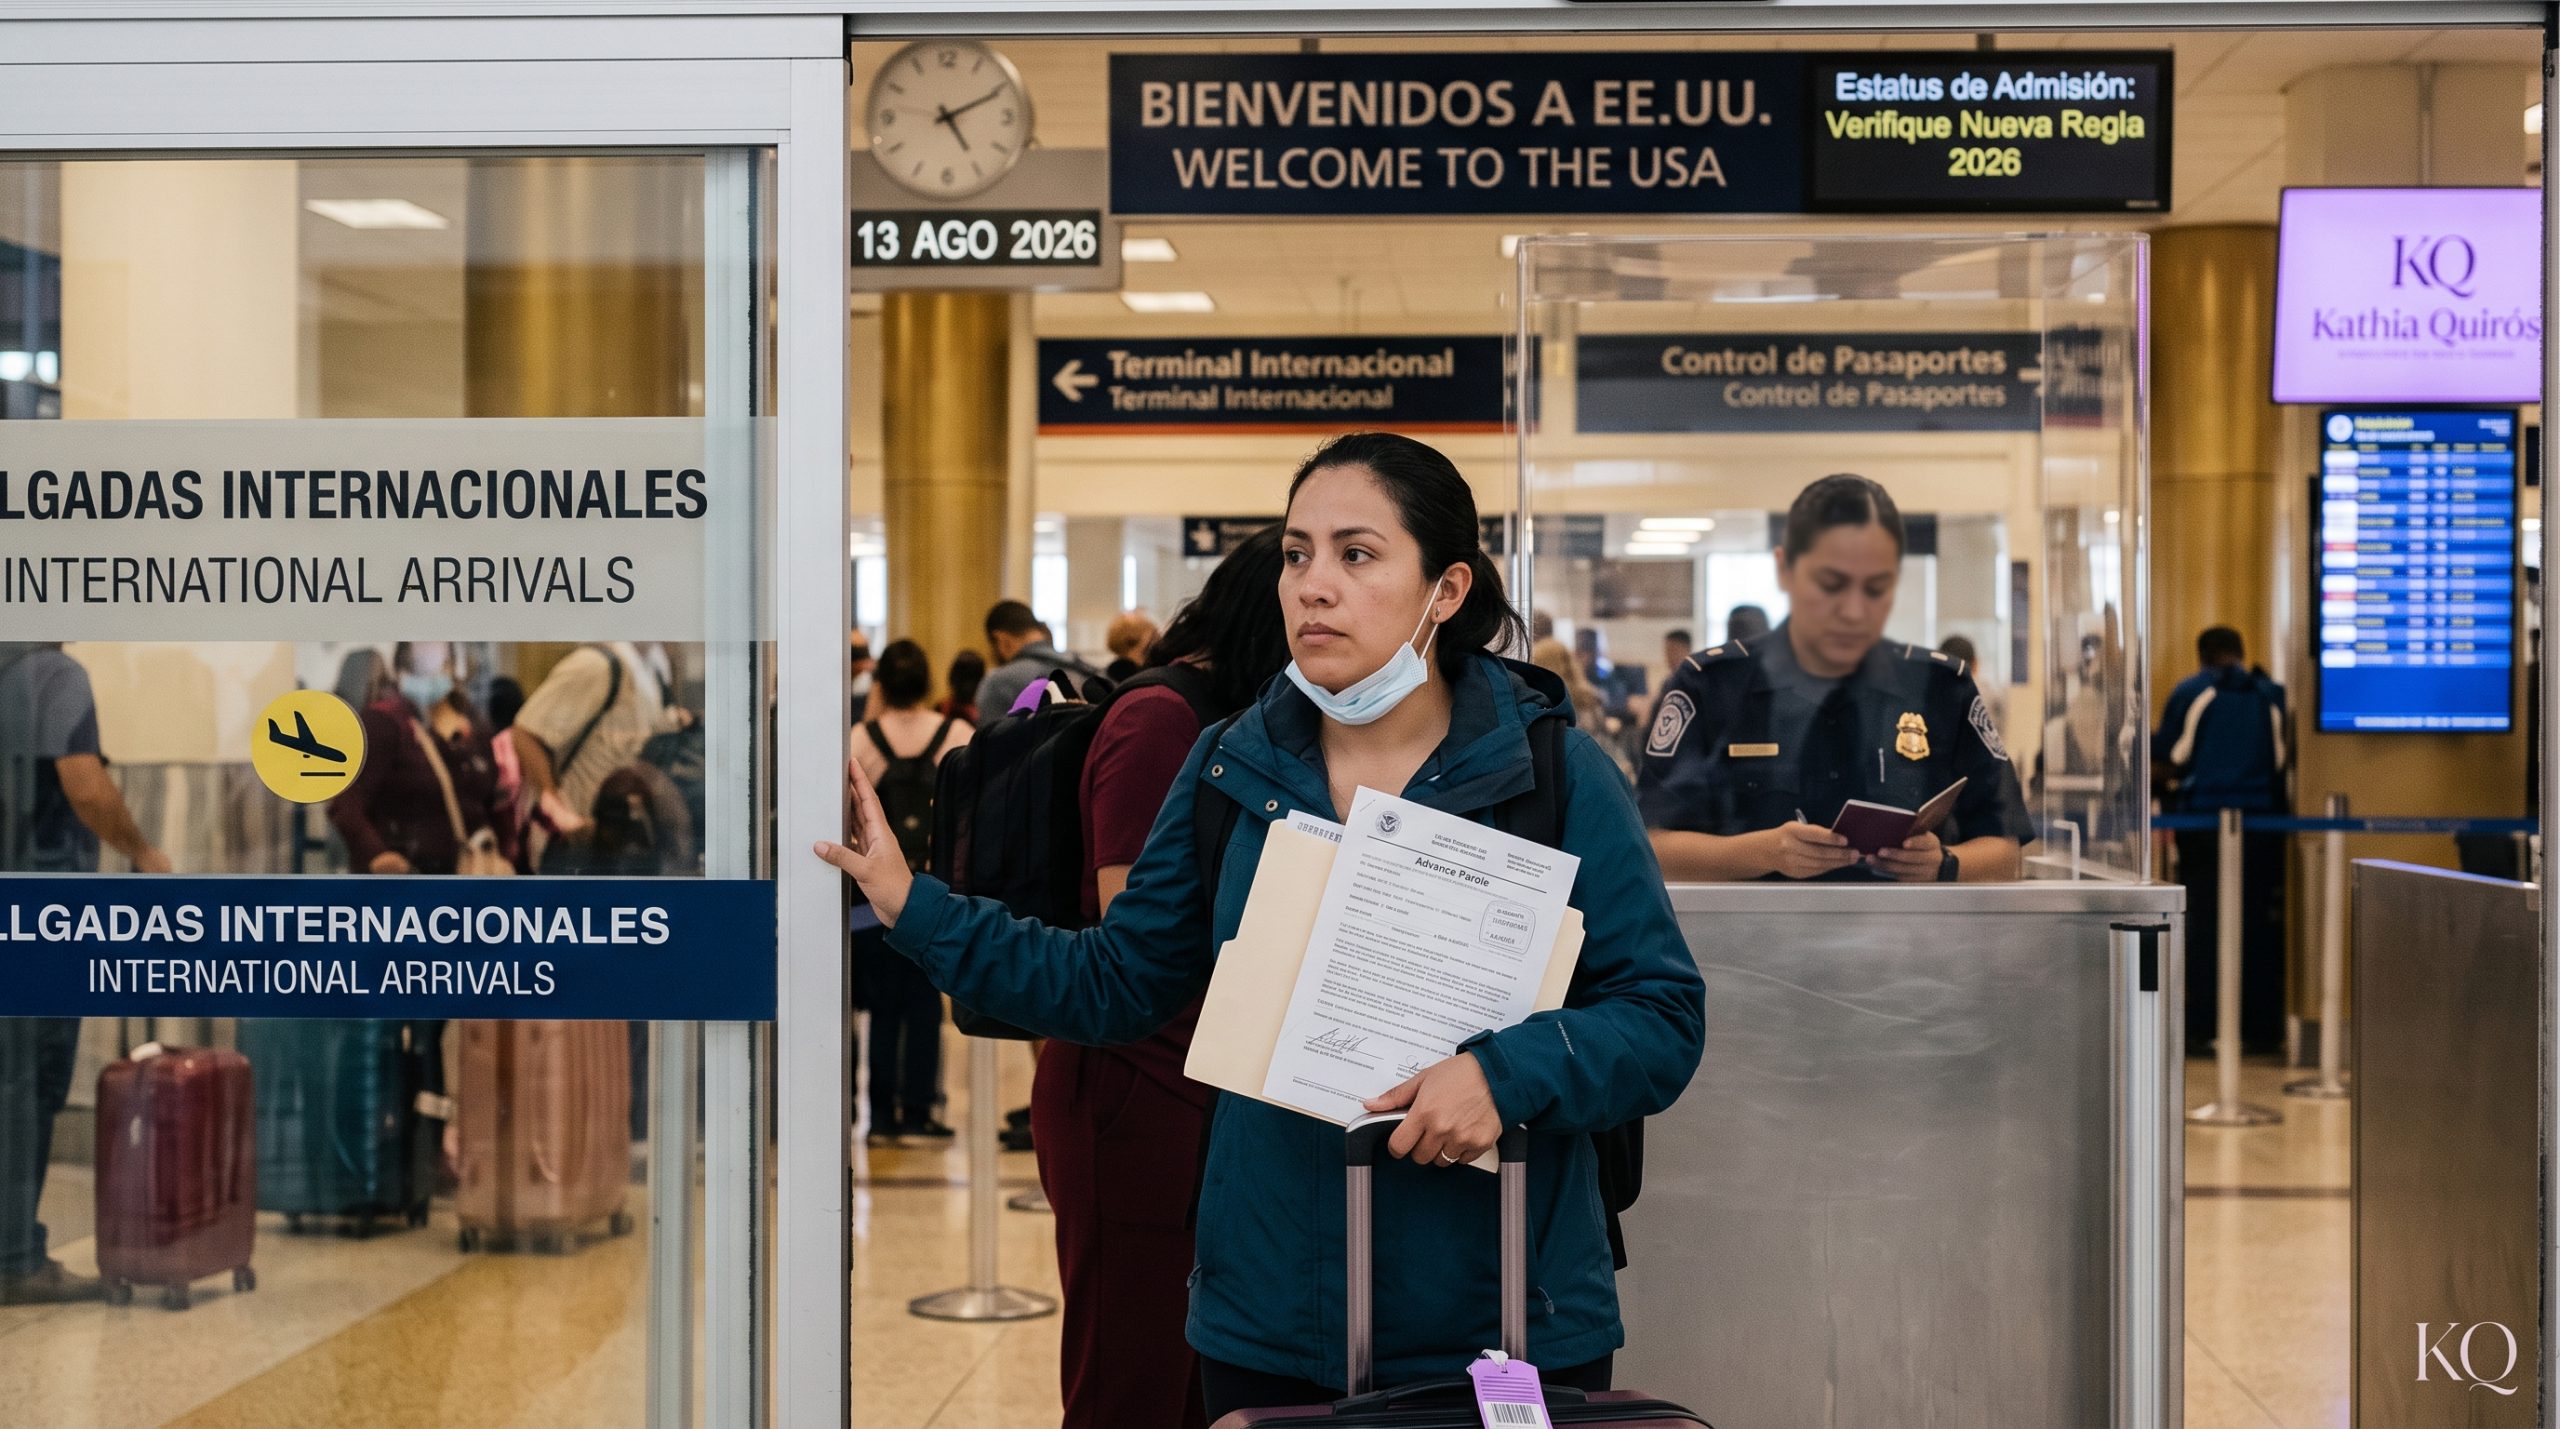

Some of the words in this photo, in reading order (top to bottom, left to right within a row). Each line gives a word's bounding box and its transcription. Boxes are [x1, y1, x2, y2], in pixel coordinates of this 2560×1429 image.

[1141, 80, 1515, 128] BIENVENIDOS
[1533, 81, 1575, 126] A
[1594, 79, 1772, 126] EE.UU.
[1836, 72, 1944, 101] Estatus
[1950, 71, 1988, 101] de
[1992, 71, 2136, 101] Admisión:
[1825, 110, 1953, 144] Verifique
[1960, 110, 2053, 139] Nueva
[2060, 109, 2145, 145] Regla
[1172, 147, 1422, 189] WELCOME
[1436, 147, 1505, 189] TO
[1519, 147, 1612, 188] THE
[1629, 146, 1727, 188] USA
[1948, 147, 2022, 177] 2026
[857, 220, 900, 260] 13
[911, 219, 999, 260] AGO
[1009, 219, 1097, 260] 2026
[2392, 234, 2477, 298] KQ
[2312, 307, 2420, 341] Kathia
[2428, 307, 2540, 348] Quirós
[1107, 349, 1243, 379] Terminal
[1250, 347, 1454, 378] Internacional
[1662, 346, 1777, 375] Control
[1786, 346, 1826, 375] de
[1834, 345, 2007, 381] Pasaportes
[1109, 385, 1219, 410] Terminal
[1224, 384, 1393, 410] Internacional
[1723, 381, 1820, 407] Control
[1826, 382, 1860, 407] de
[1866, 381, 2006, 412] Pasaportes
[223, 469, 708, 520] INTERNACIONALES
[5, 557, 383, 603] INTERNATIONAL
[397, 556, 635, 604] ARRIVALS
[1415, 857, 1457, 877] Advance
[1458, 870, 1490, 888] Parole
[0, 903, 204, 943] LGADAS
[220, 905, 670, 945] INTERNACIONALES
[89, 959, 370, 994] INTERNATIONAL
[380, 960, 556, 996] ARRIVALS
